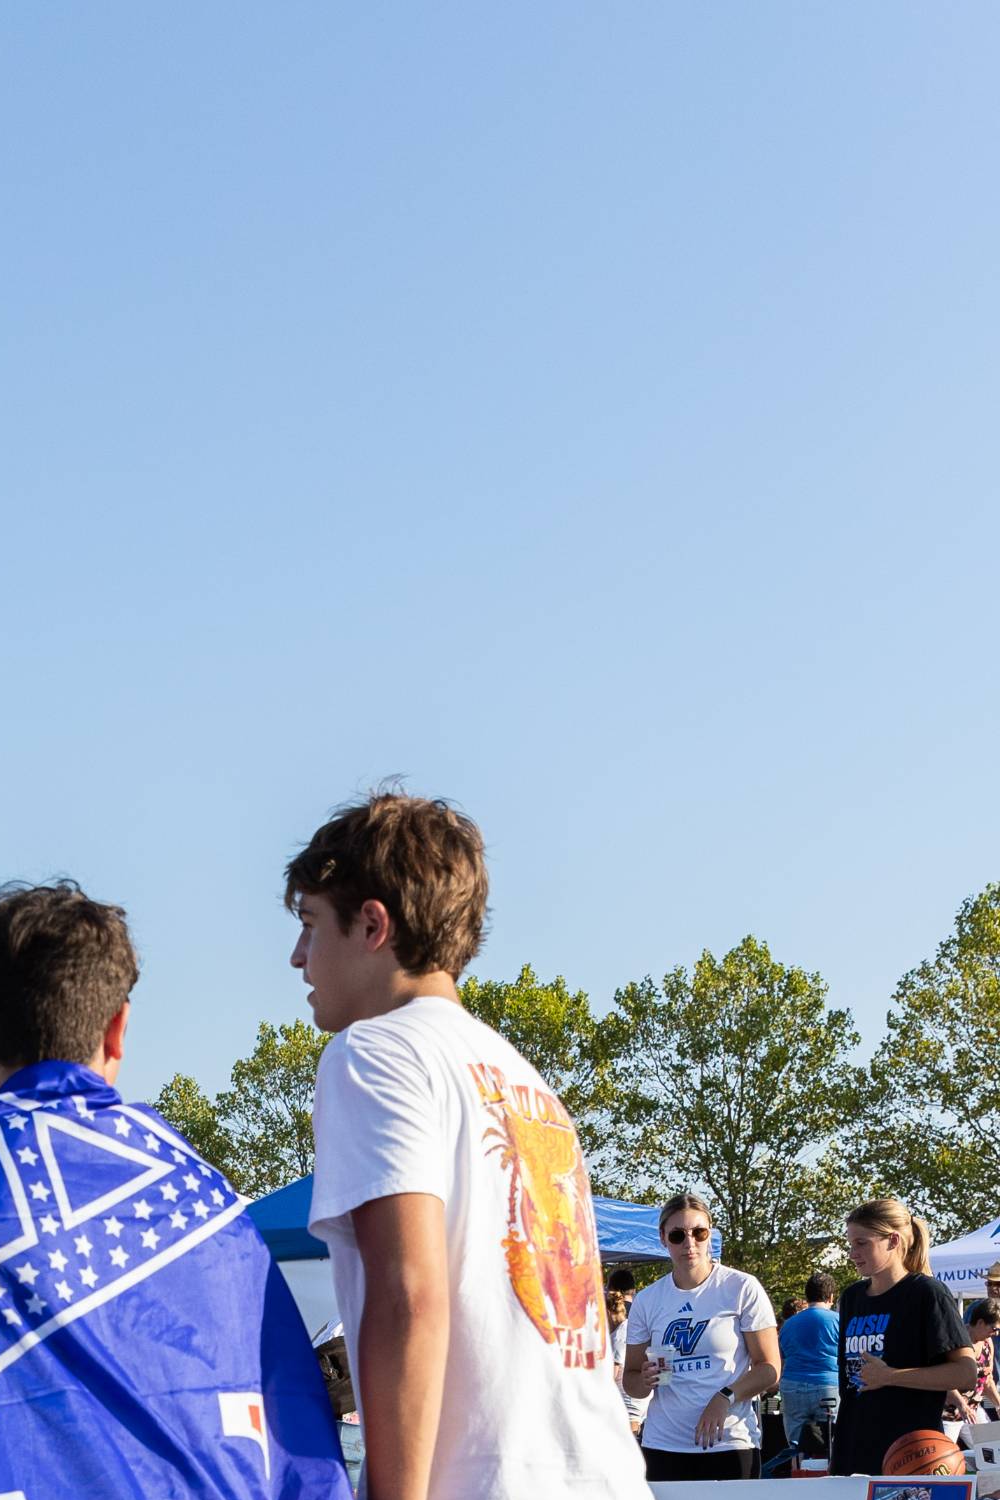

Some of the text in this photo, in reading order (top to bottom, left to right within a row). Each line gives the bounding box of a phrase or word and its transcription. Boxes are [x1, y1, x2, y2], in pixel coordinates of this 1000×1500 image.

[846, 1313, 890, 1336] GVSU
[661, 1317, 711, 1357] GV
[845, 1333, 885, 1354] HOOPS
[672, 1360, 711, 1374] KERS
